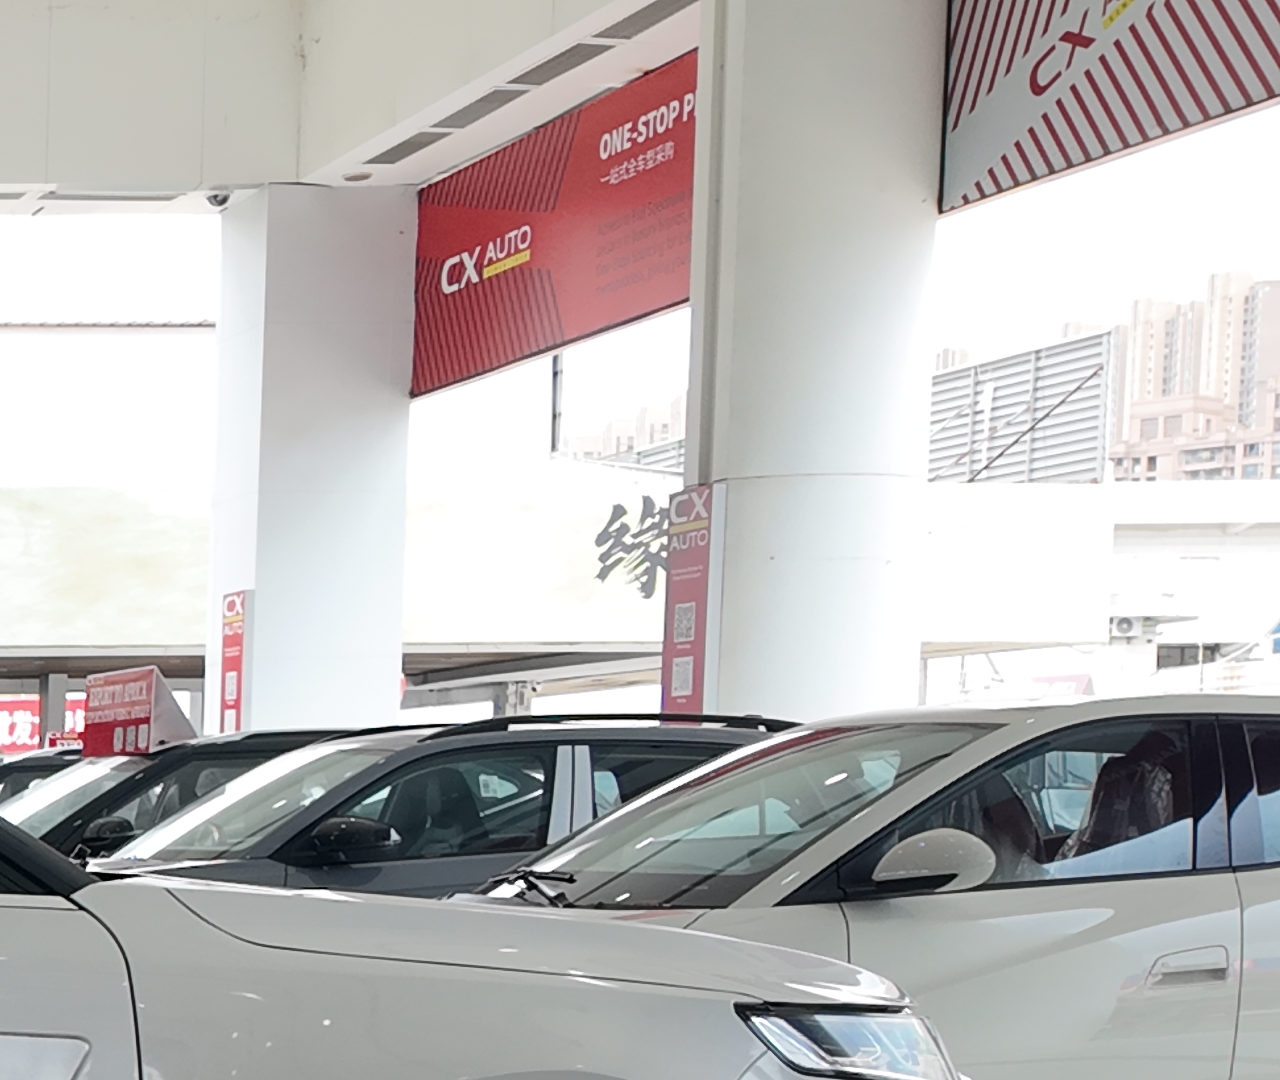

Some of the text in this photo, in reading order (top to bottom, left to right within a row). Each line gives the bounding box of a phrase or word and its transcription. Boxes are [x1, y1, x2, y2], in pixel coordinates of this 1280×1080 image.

[1029, 6, 1096, 97] CX
[599, 92, 698, 160] ONE-STOP P
[441, 245, 482, 294] CX
[483, 225, 532, 266] AUTO
[669, 489, 710, 524] CX
[669, 529, 709, 552] AUTO
[224, 593, 244, 617] CX
